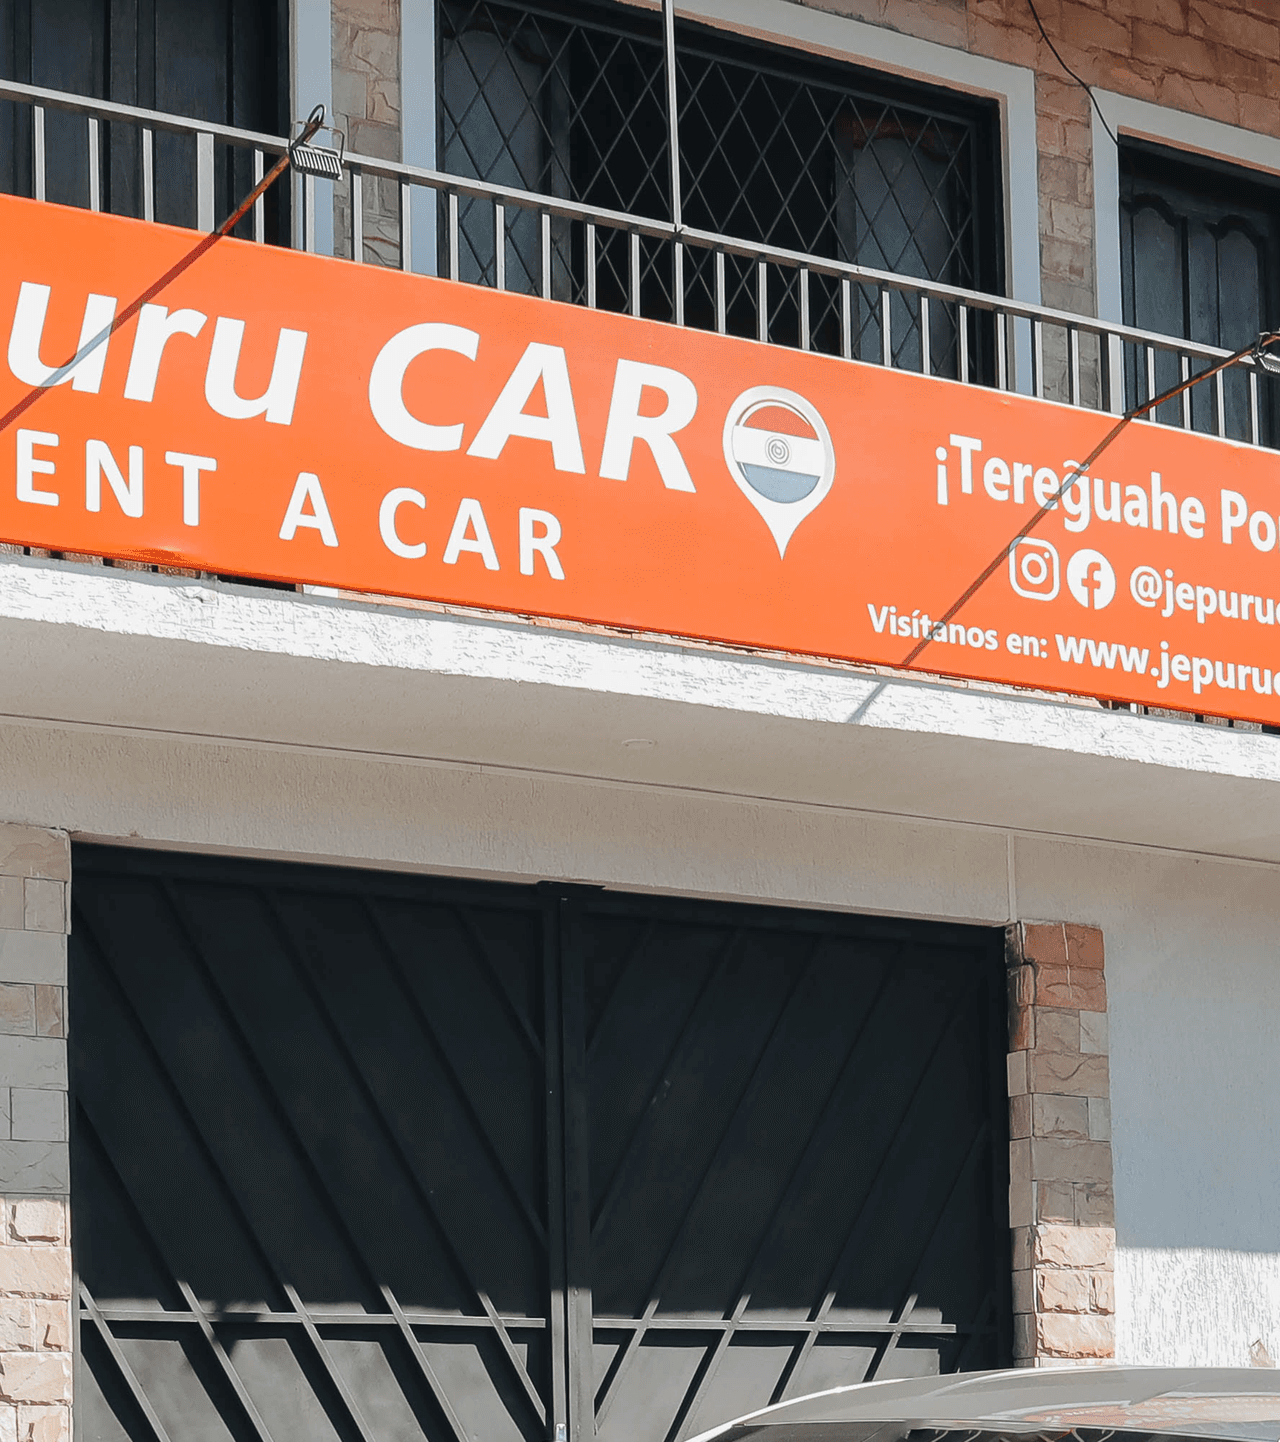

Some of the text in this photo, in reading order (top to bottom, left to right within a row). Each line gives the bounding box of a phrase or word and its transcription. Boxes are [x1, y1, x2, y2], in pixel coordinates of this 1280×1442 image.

[368, 322, 699, 493] CAR
[279, 472, 339, 547] A
[379, 487, 565, 580] CAR
[867, 603, 999, 650] Visítanos
[1006, 633, 1049, 658] en:
